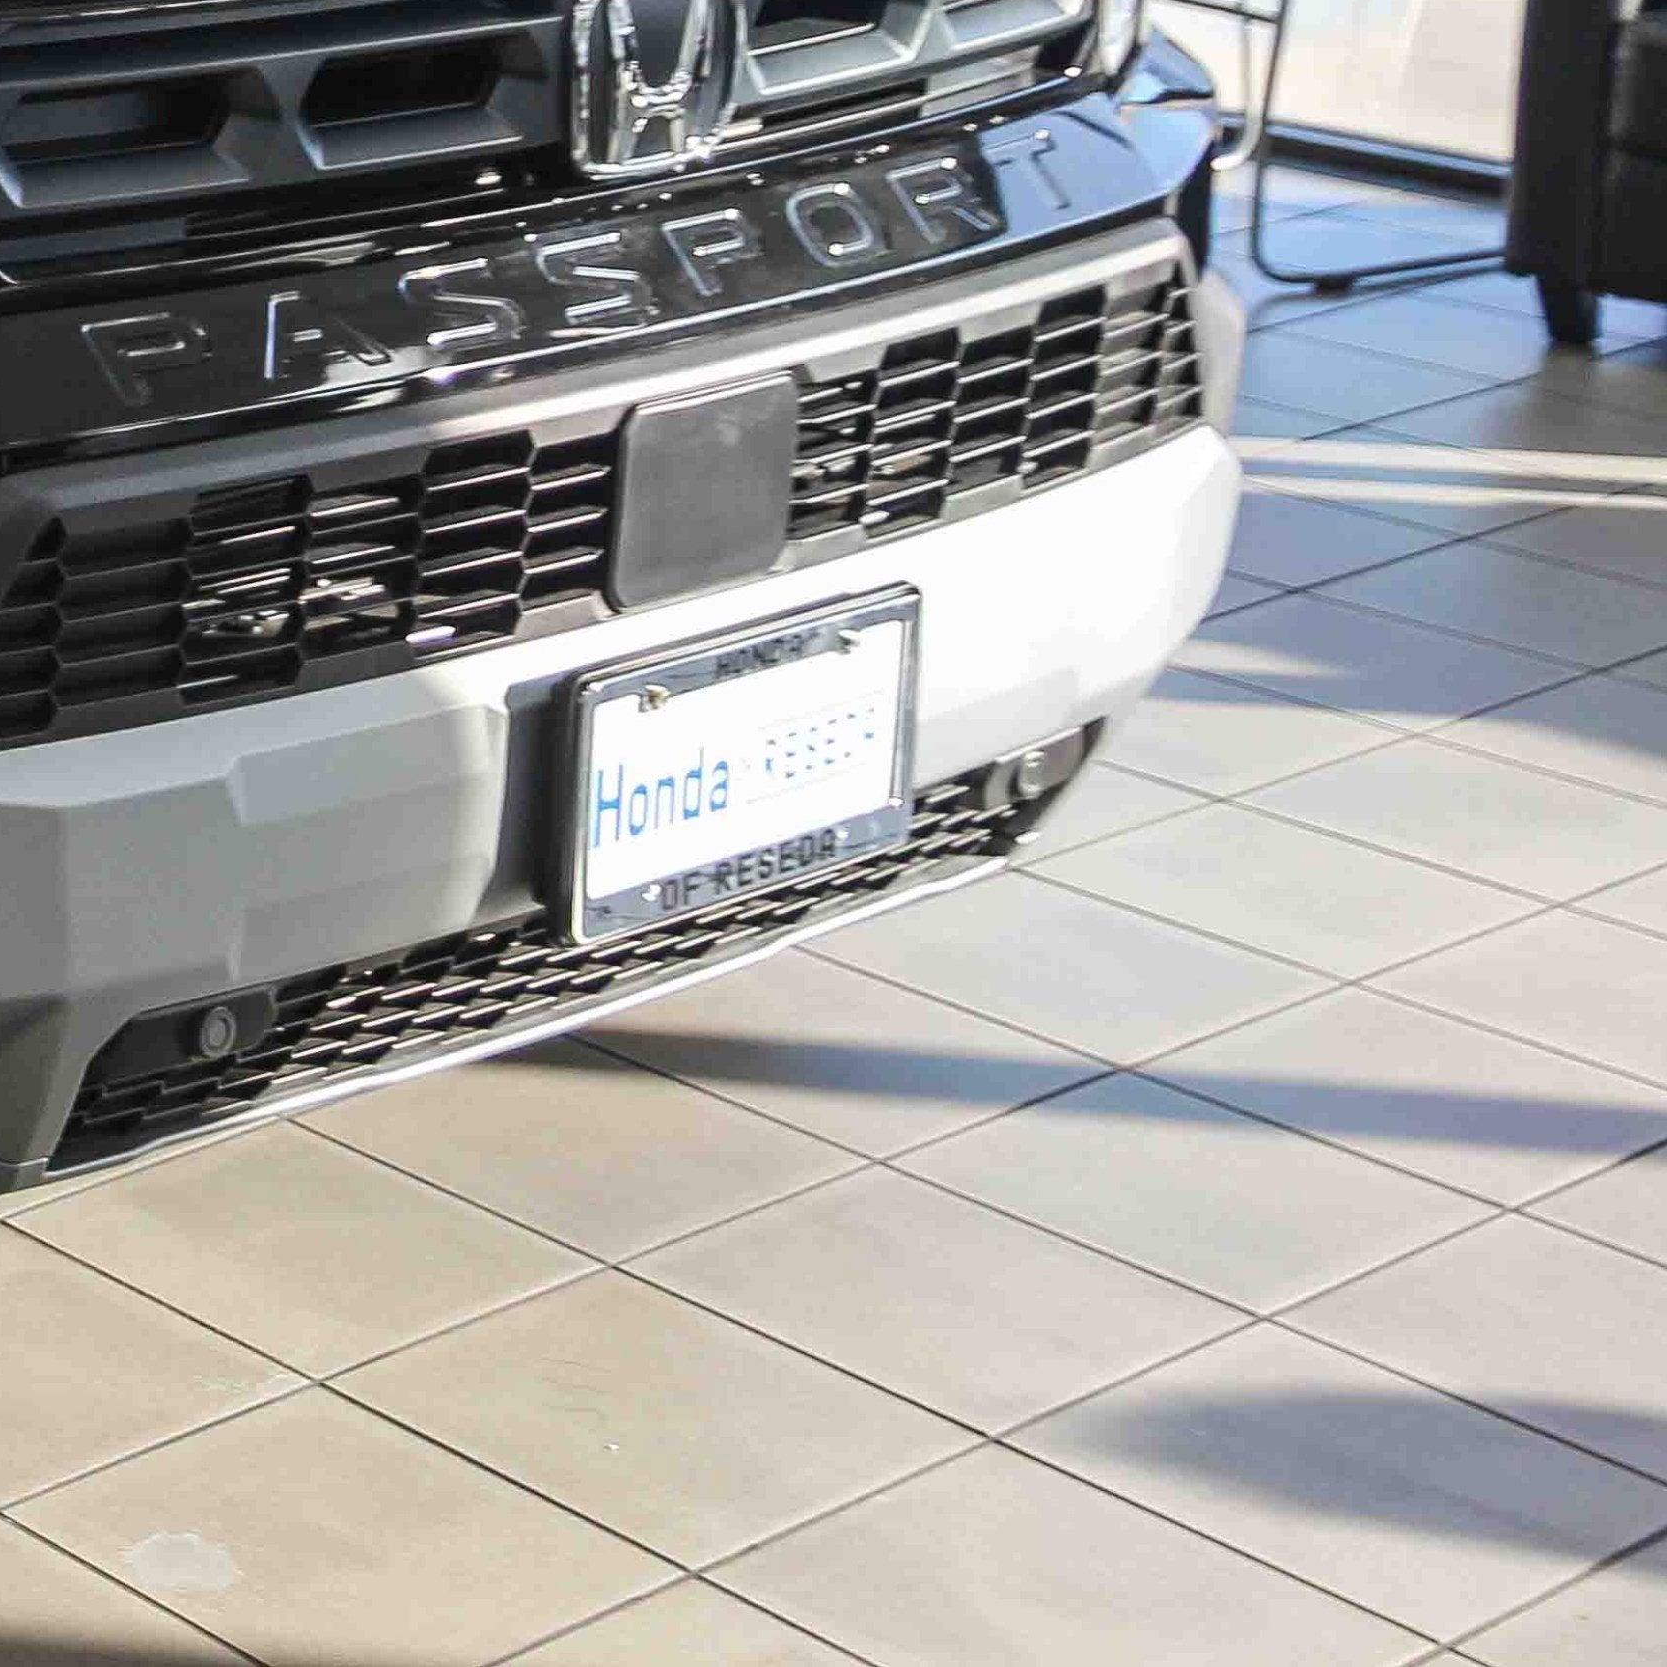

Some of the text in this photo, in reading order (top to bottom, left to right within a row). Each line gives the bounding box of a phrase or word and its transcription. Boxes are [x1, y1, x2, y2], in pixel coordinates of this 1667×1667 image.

[79, 128, 1075, 406] PASSPORT
[592, 746, 730, 849] Honda
[661, 828, 839, 912] OF RESEDA
